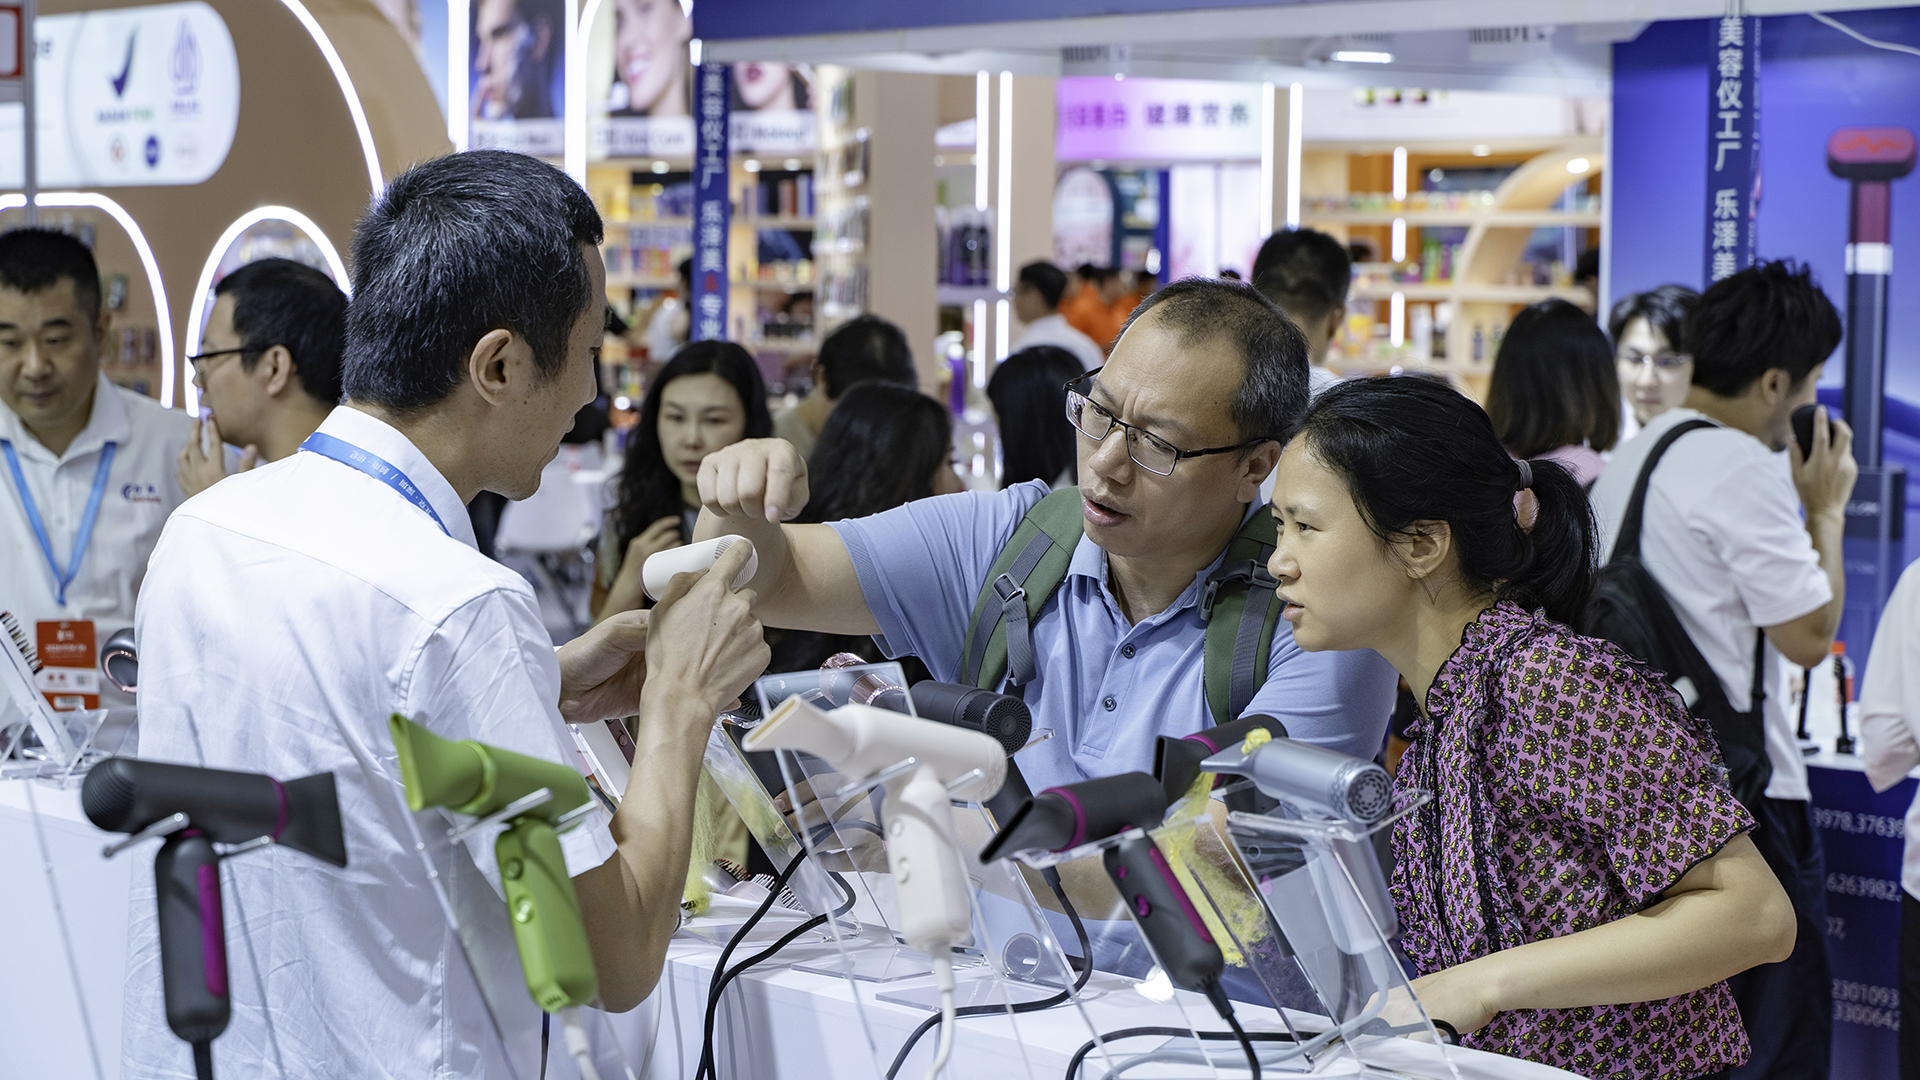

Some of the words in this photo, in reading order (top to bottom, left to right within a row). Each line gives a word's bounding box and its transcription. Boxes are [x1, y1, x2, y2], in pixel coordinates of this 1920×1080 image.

[1714, 17, 1745, 172] 美容仪工厂
[1711, 188, 1739, 281] 乐泽美
